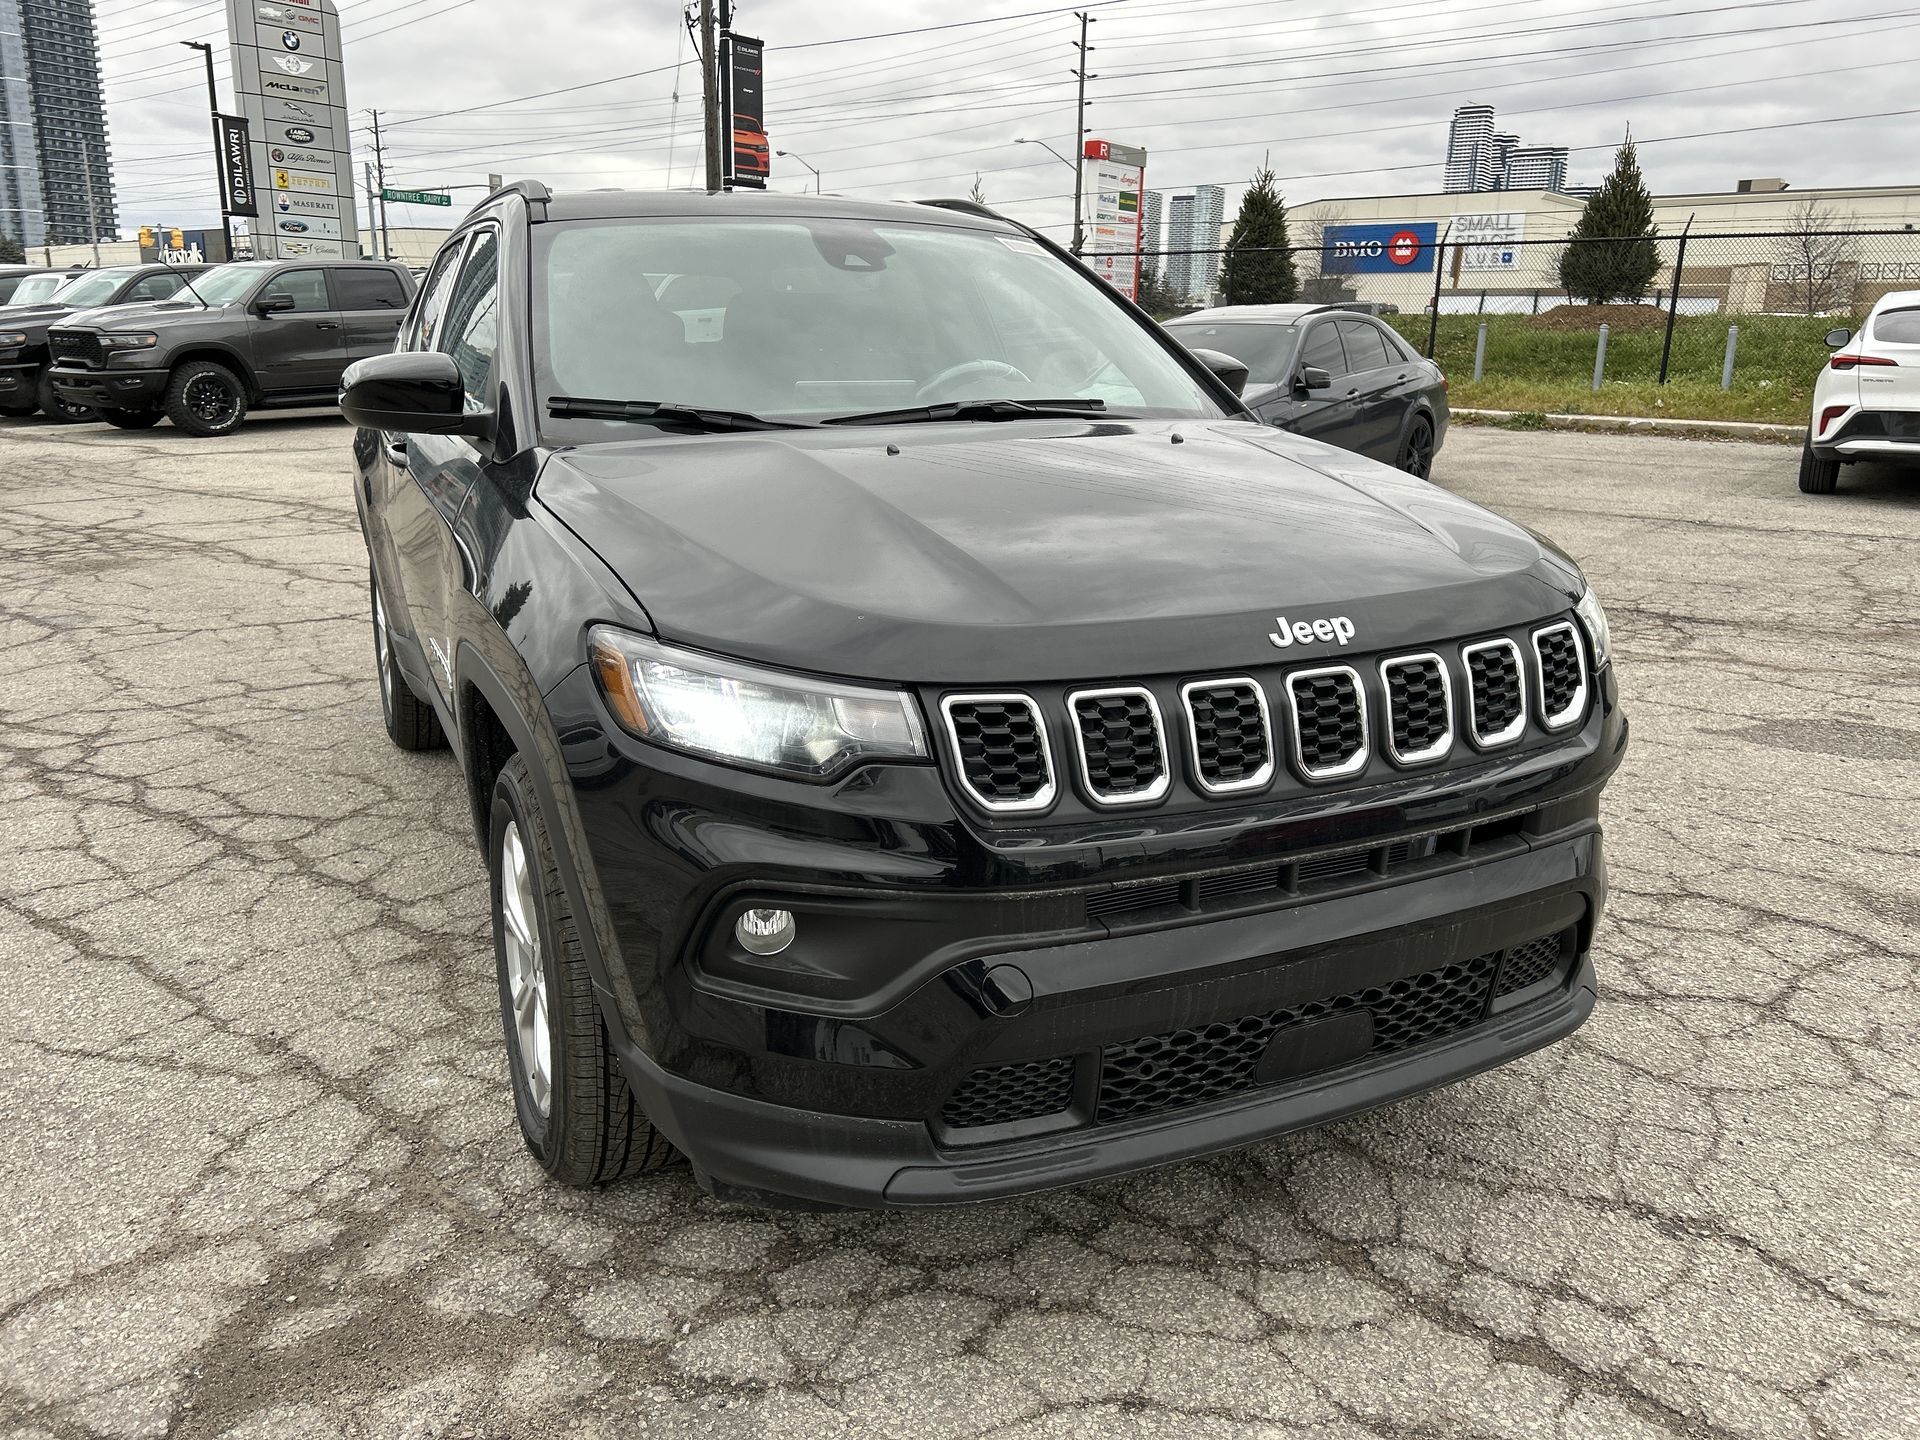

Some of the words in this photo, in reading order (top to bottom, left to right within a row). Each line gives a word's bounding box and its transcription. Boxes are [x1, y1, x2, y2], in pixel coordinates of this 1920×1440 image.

[298, 15, 320, 24] GMC
[265, 82, 320, 95] McLaren
[1100, 143, 1108, 156] R
[229, 128, 244, 188] DILAWRI
[287, 152, 305, 163] Alfa
[306, 154, 332, 164] Romeo
[386, 190, 420, 202] ROWNTREE
[424, 194, 440, 204] DAIRY
[293, 200, 334, 210] MASERATI
[284, 222, 302, 232] Ford
[1456, 214, 1515, 232] SMALL
[1334, 240, 1382, 257] BMO
[1268, 616, 1356, 648] Jeep
